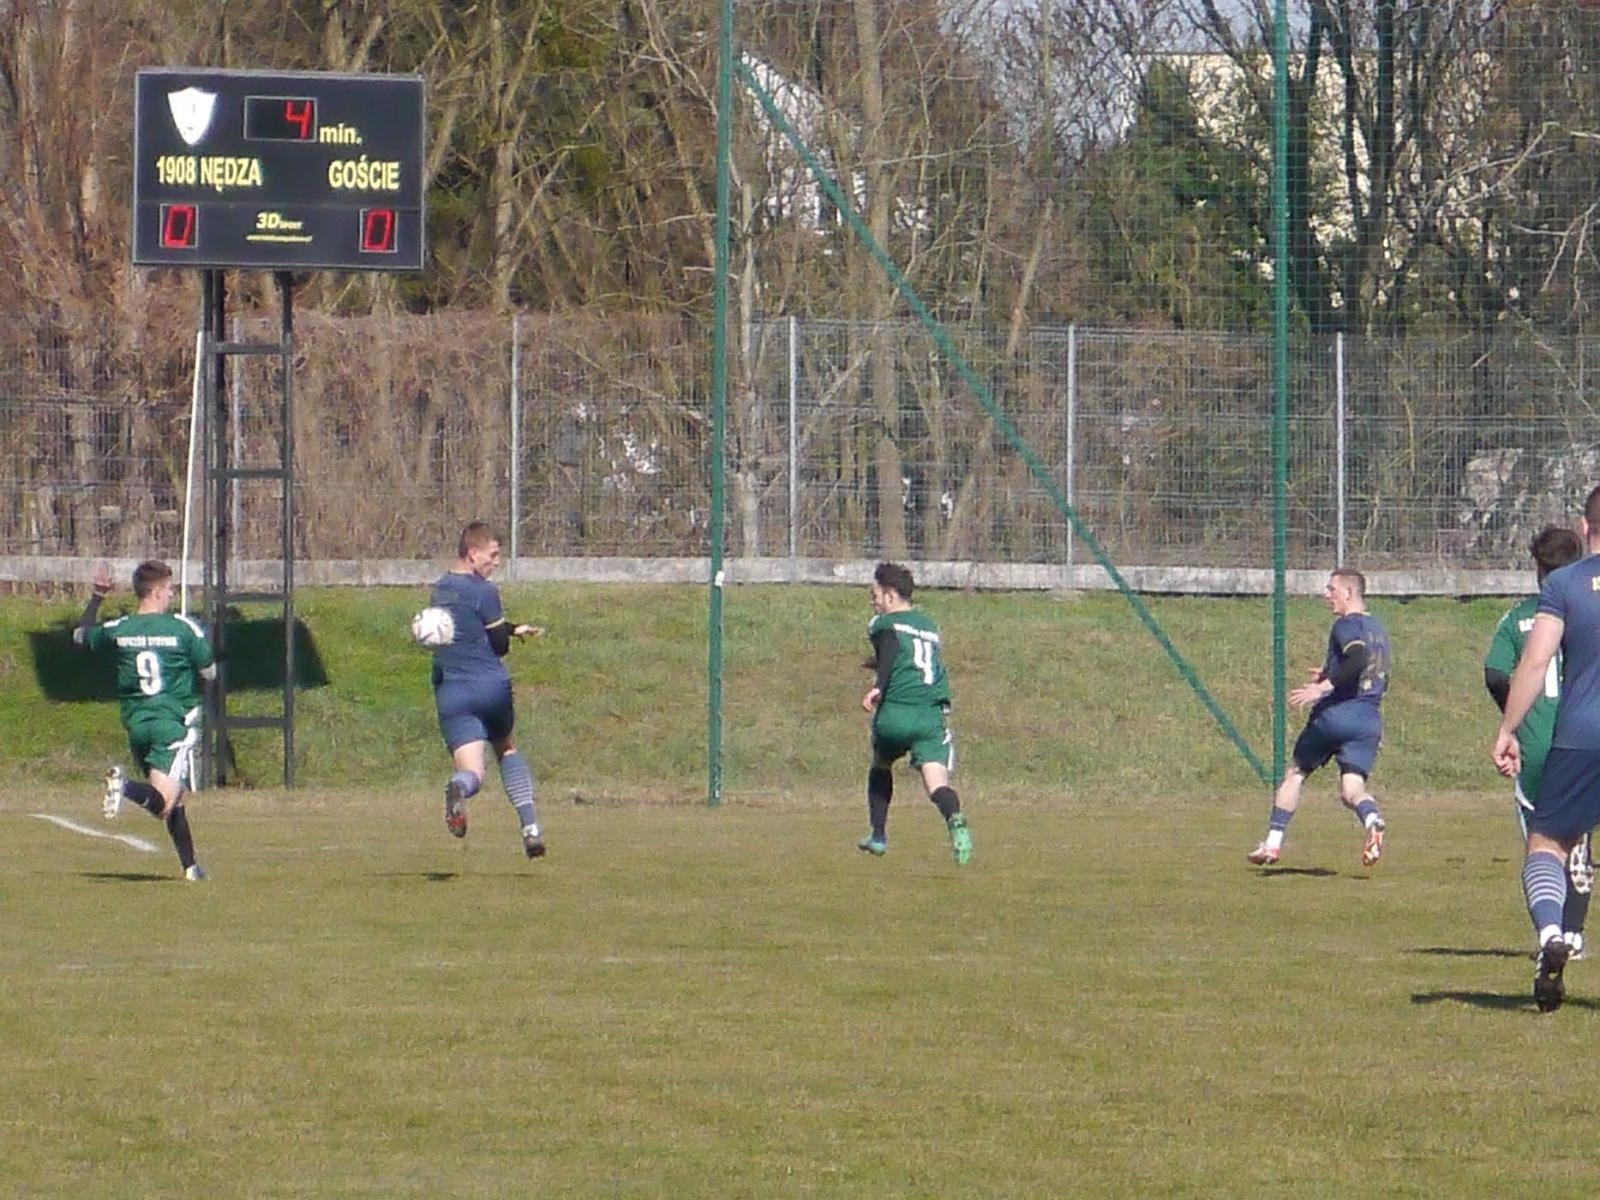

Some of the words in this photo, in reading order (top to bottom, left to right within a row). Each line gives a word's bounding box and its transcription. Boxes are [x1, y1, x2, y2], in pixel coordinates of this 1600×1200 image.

[284, 100, 313, 139] 4
[156, 155, 198, 186] 1908
[200, 156, 263, 192] NĘDZA
[328, 154, 400, 191] GOŚCIE
[162, 203, 195, 248] 0
[362, 208, 394, 251] 0
[136, 650, 163, 696] 9
[912, 638, 934, 686] 4
